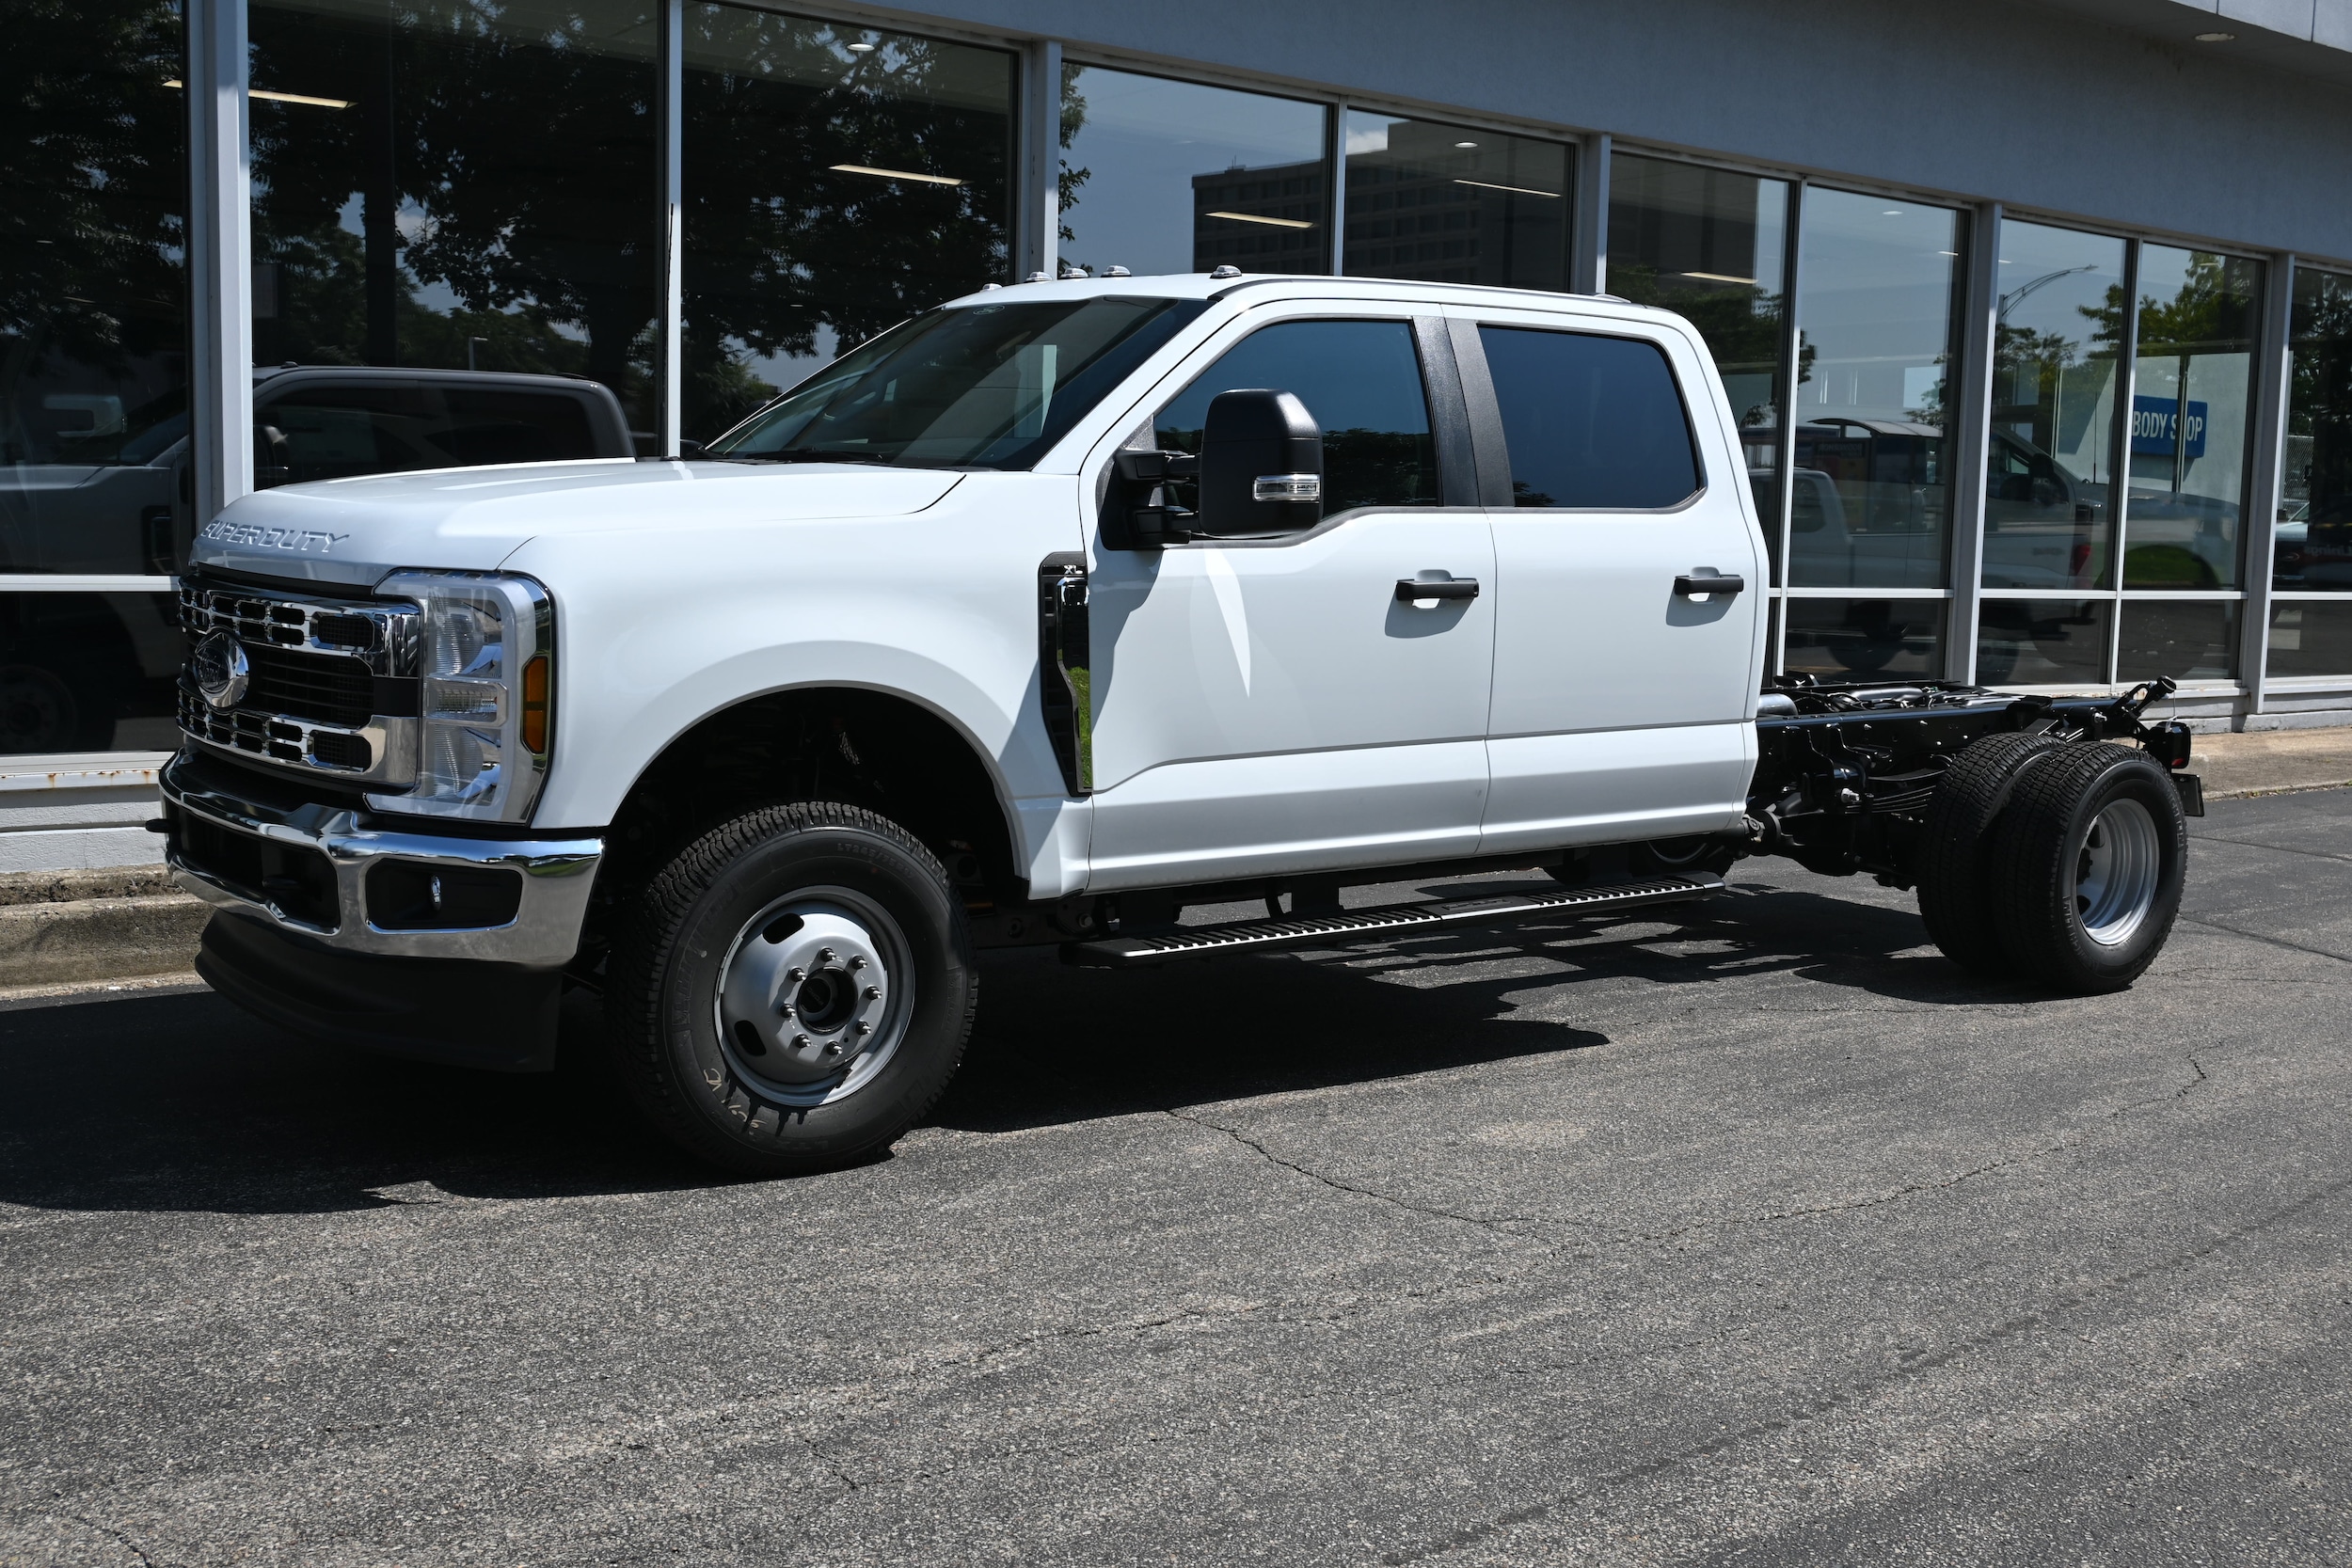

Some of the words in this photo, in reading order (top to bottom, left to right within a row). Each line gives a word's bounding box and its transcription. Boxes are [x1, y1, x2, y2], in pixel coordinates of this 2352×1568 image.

[2133, 410, 2168, 439] BODY
[2170, 414, 2203, 442] SOP
[200, 519, 264, 546] SUPER
[258, 528, 350, 553] DUTY
[1063, 564, 1084, 575] XL
